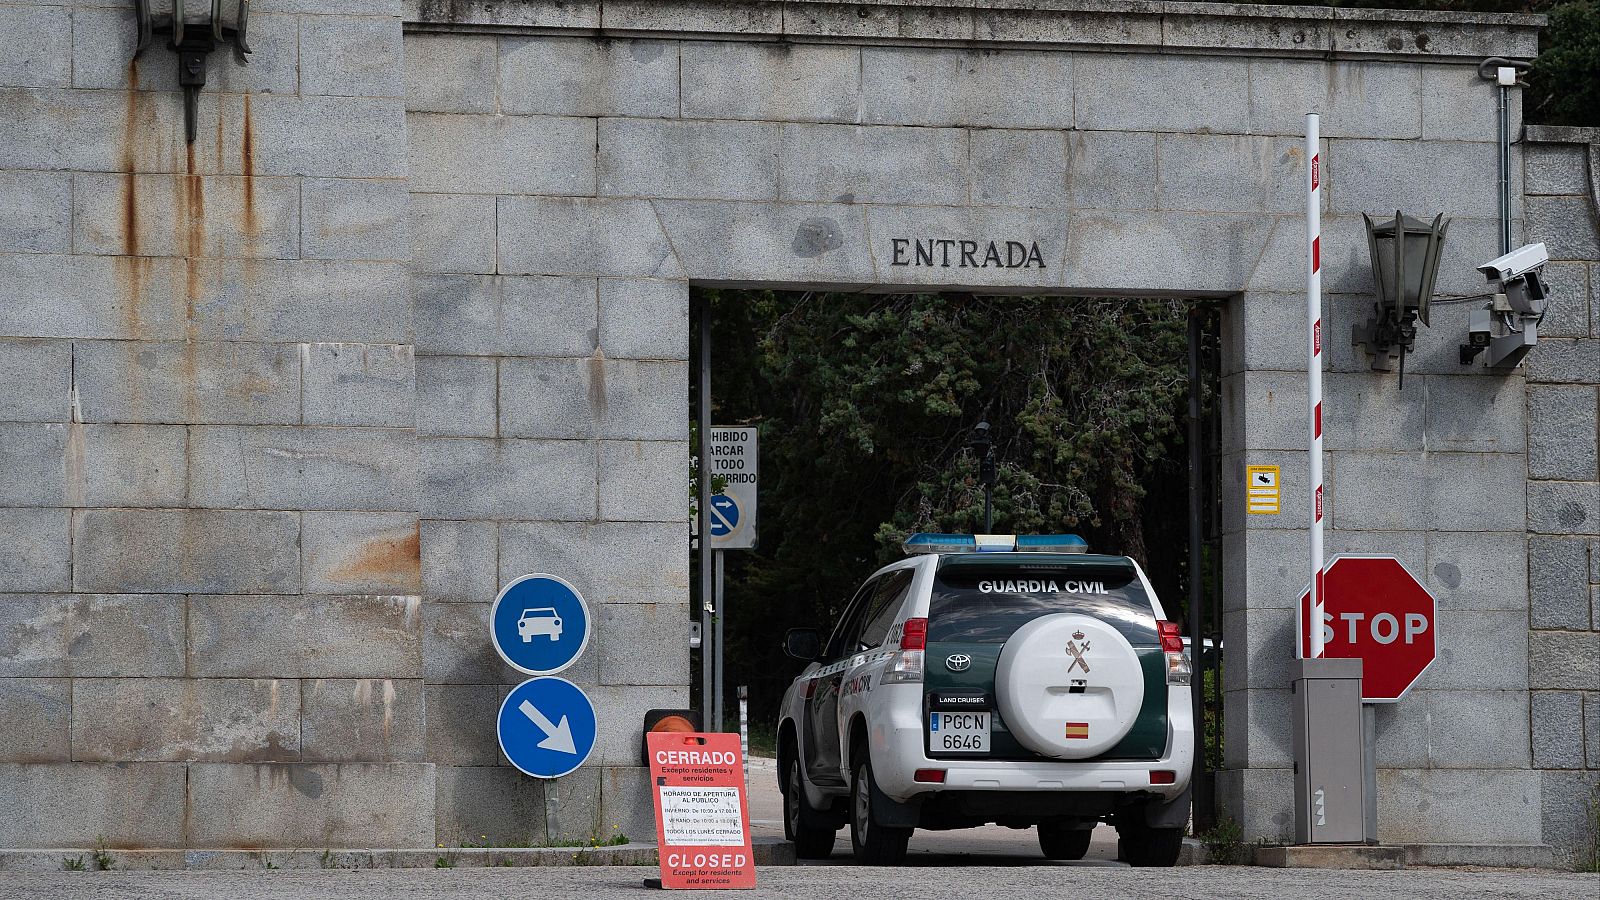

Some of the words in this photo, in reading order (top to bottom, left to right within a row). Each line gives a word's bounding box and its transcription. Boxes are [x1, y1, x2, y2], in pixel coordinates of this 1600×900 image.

[891, 238, 1047, 269] ENTRADA
[714, 459, 744, 470] TODO
[978, 580, 1059, 594] GUARDIA
[1064, 580, 1109, 595] CIVIL
[943, 734, 981, 749] 6646
[656, 750, 736, 765] CERRADO
[661, 766, 690, 775] Excepto
[691, 766, 727, 774] residentes
[668, 853, 747, 868] CLOSED
